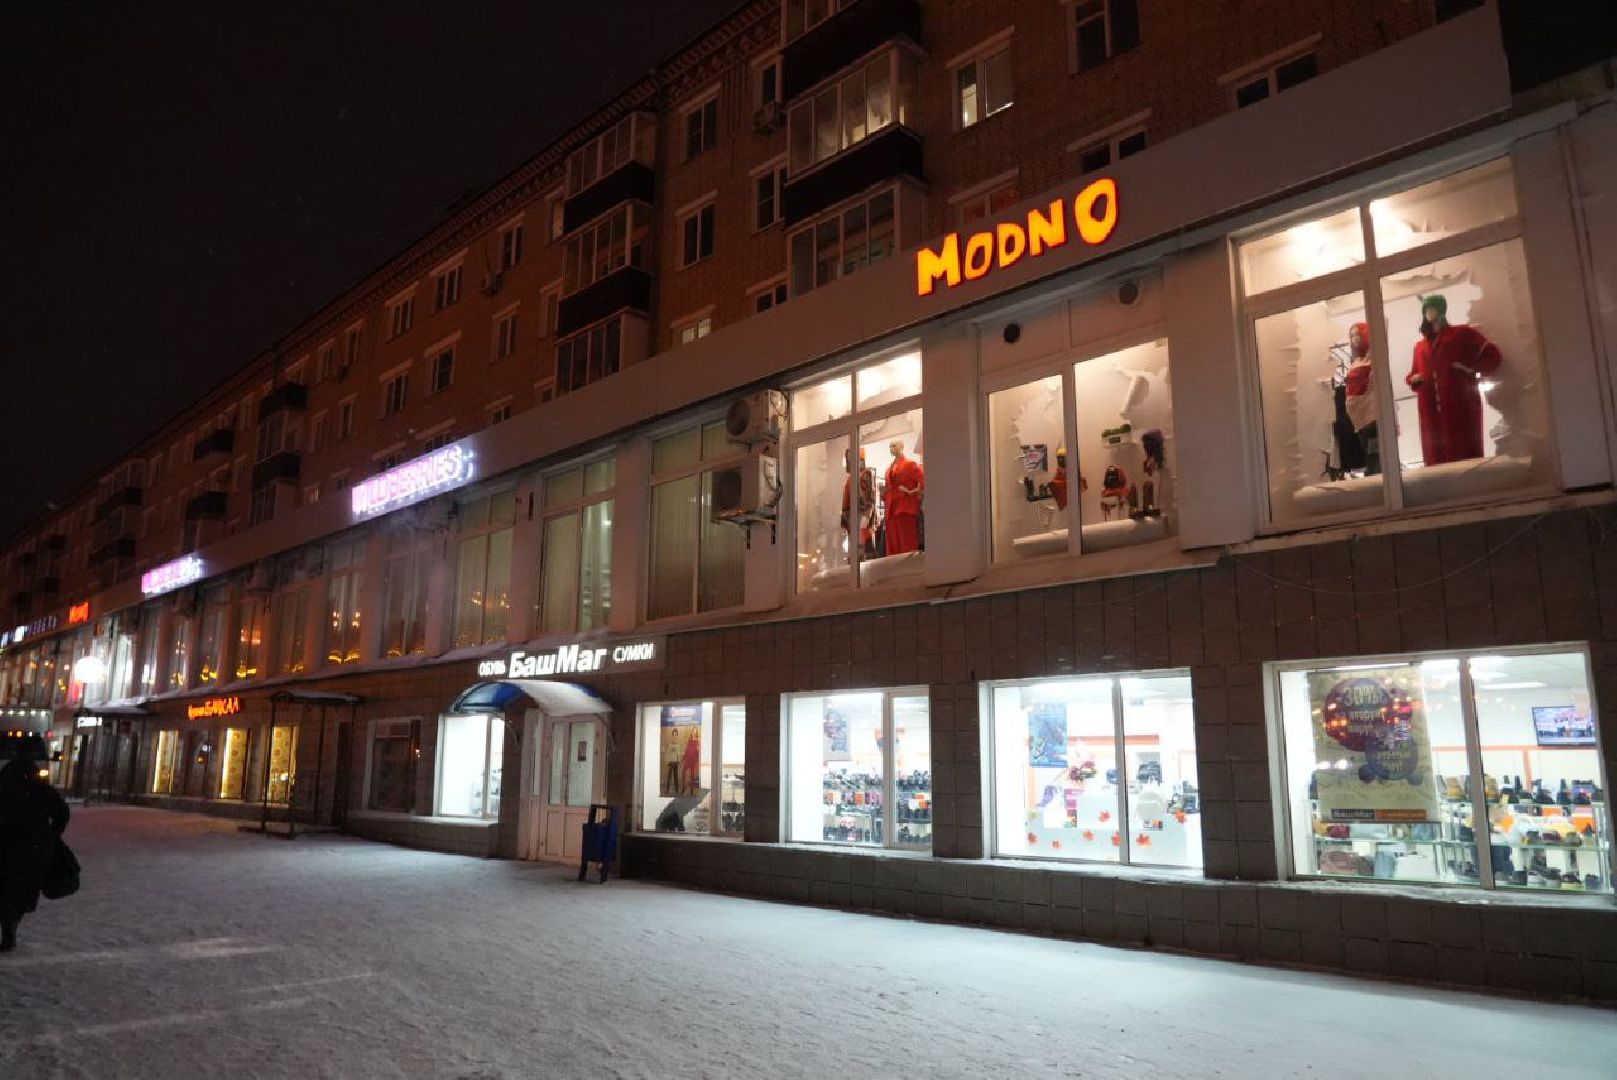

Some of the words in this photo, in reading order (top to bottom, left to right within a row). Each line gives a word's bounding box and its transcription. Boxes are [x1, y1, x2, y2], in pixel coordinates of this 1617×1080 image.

[917, 178, 1118, 295] MODNO
[508, 645, 607, 678] БашМаг
[613, 643, 655, 663] СУМКИ
